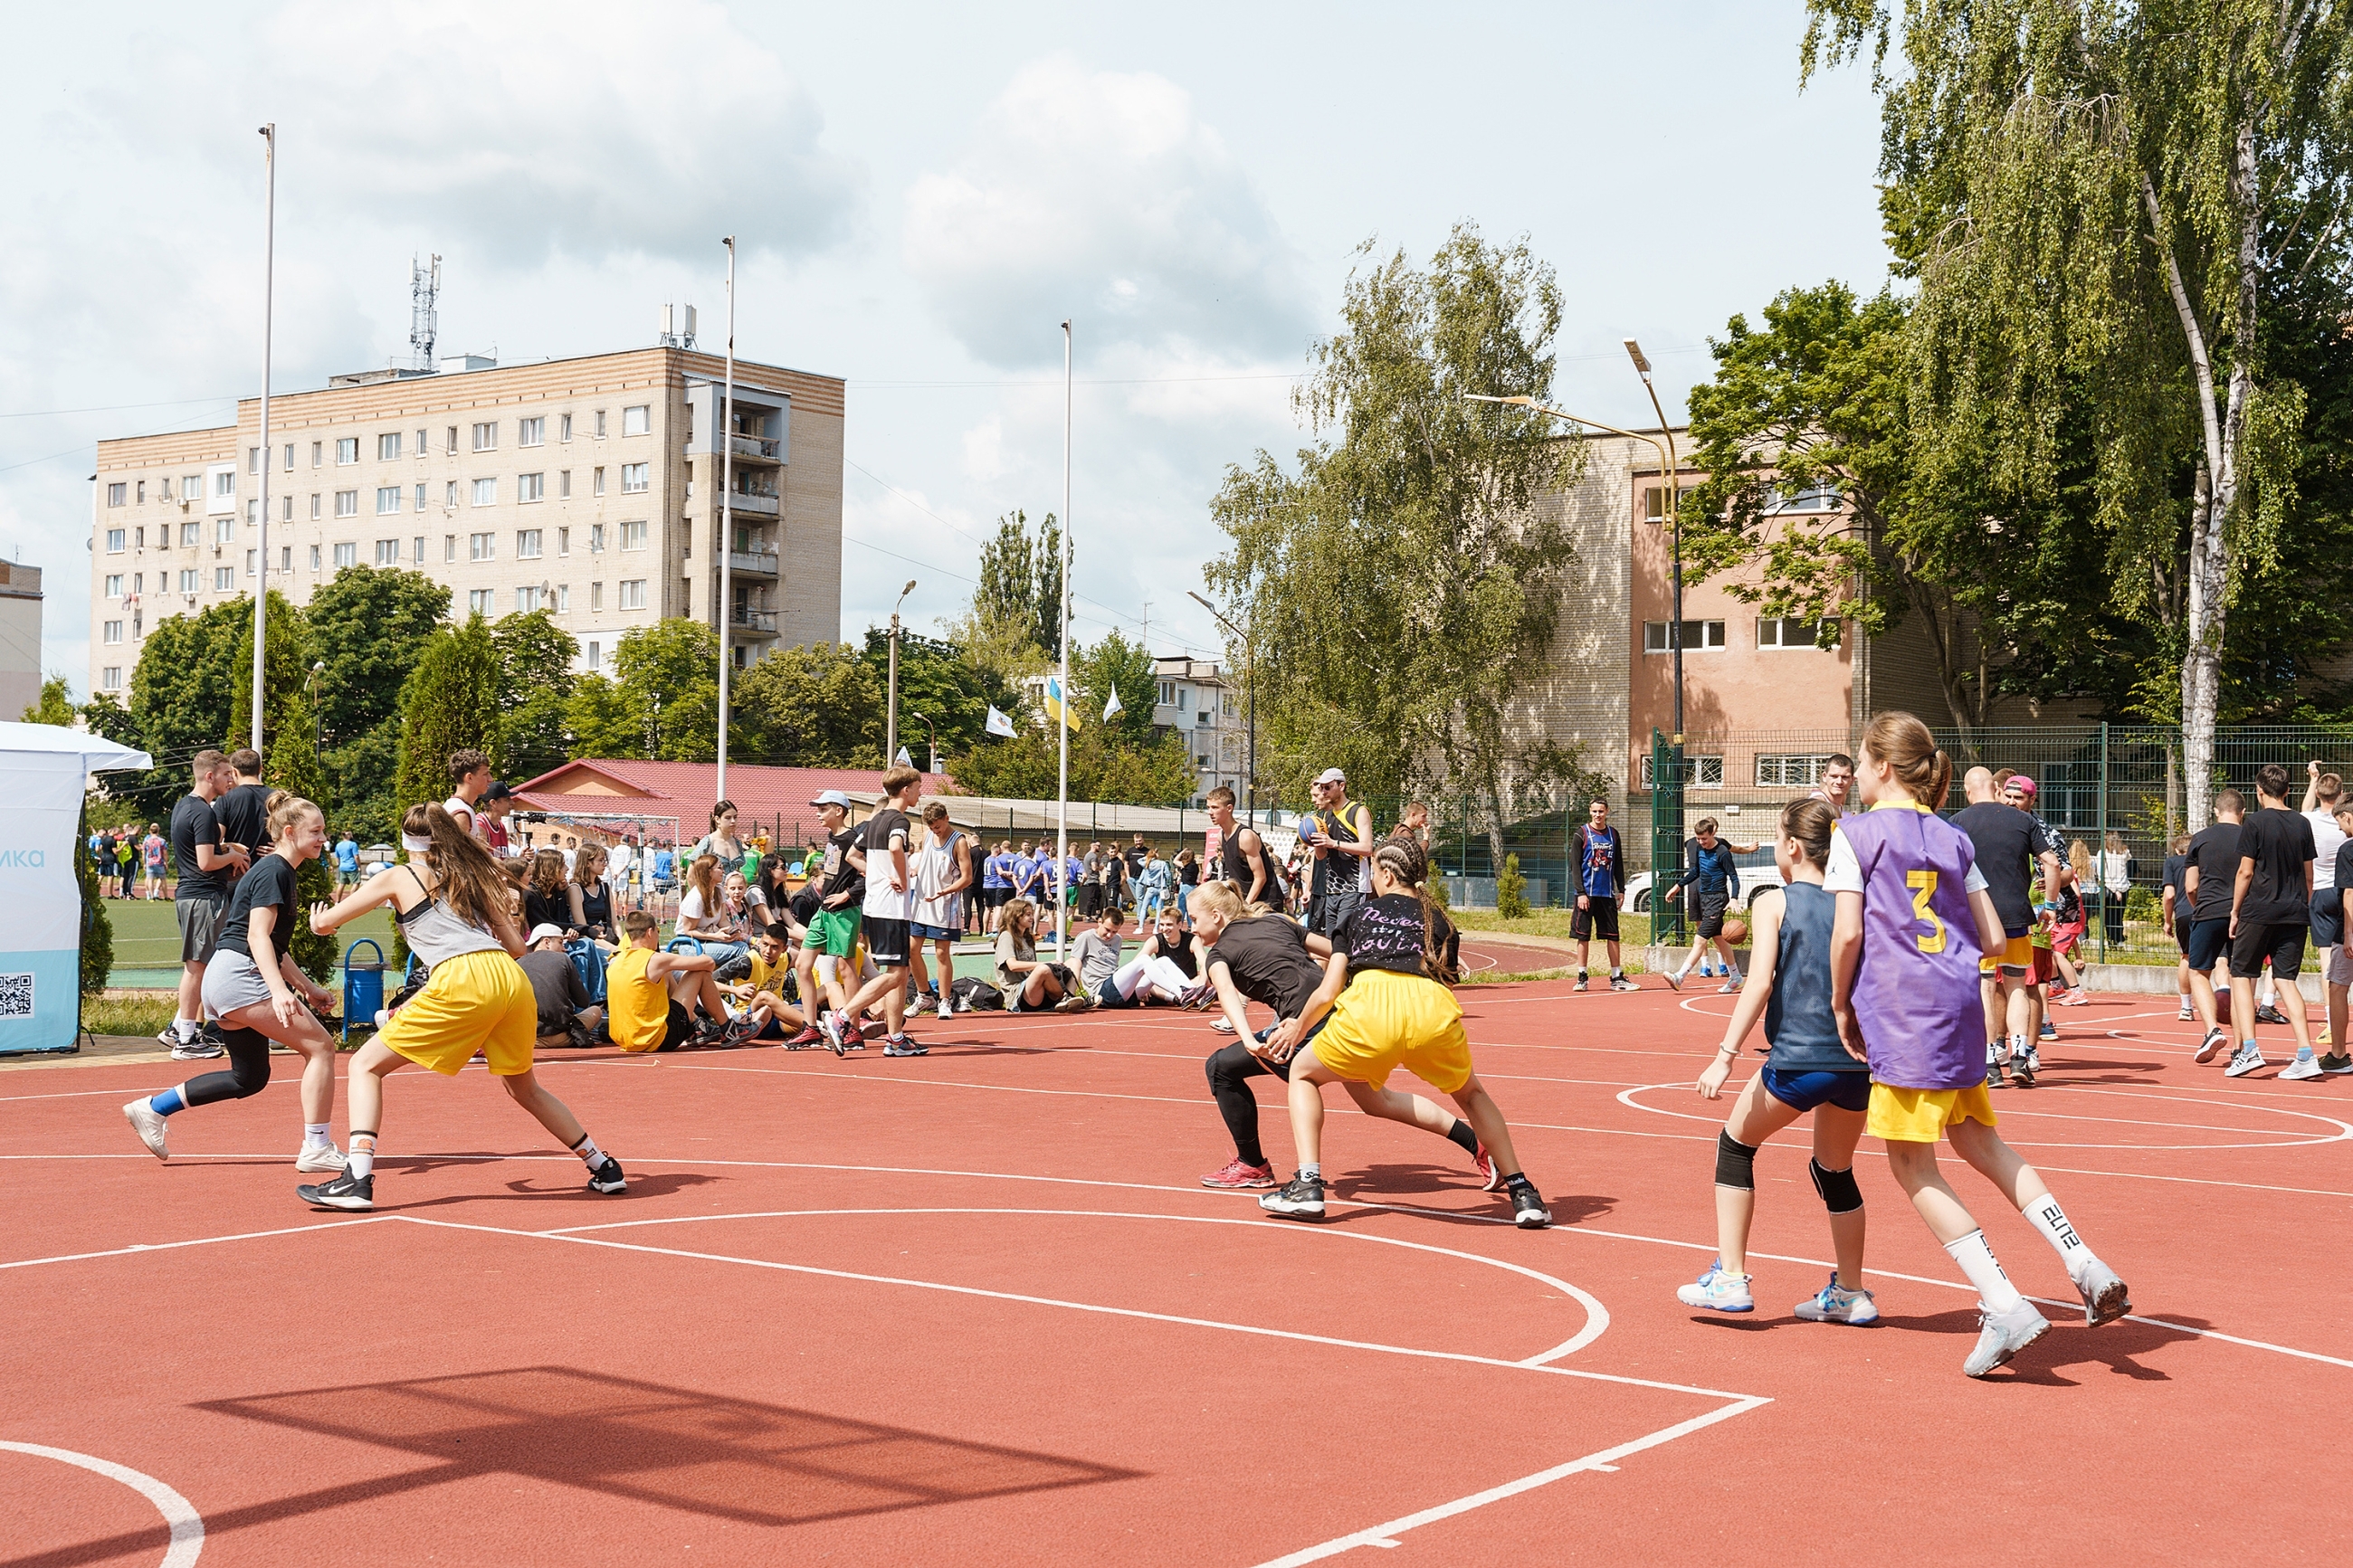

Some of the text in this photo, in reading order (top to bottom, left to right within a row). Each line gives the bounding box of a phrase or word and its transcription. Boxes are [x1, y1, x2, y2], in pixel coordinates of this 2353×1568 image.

[984, 861, 992, 876] 11
[1006, 859, 1014, 872] 7
[1018, 865, 1027, 879] 9
[1053, 864, 1059, 878] 8
[1362, 907, 1425, 930] Never
[1906, 870, 1947, 954] 3
[1371, 925, 1402, 937] stop
[2015, 1039, 2022, 1049] 7
